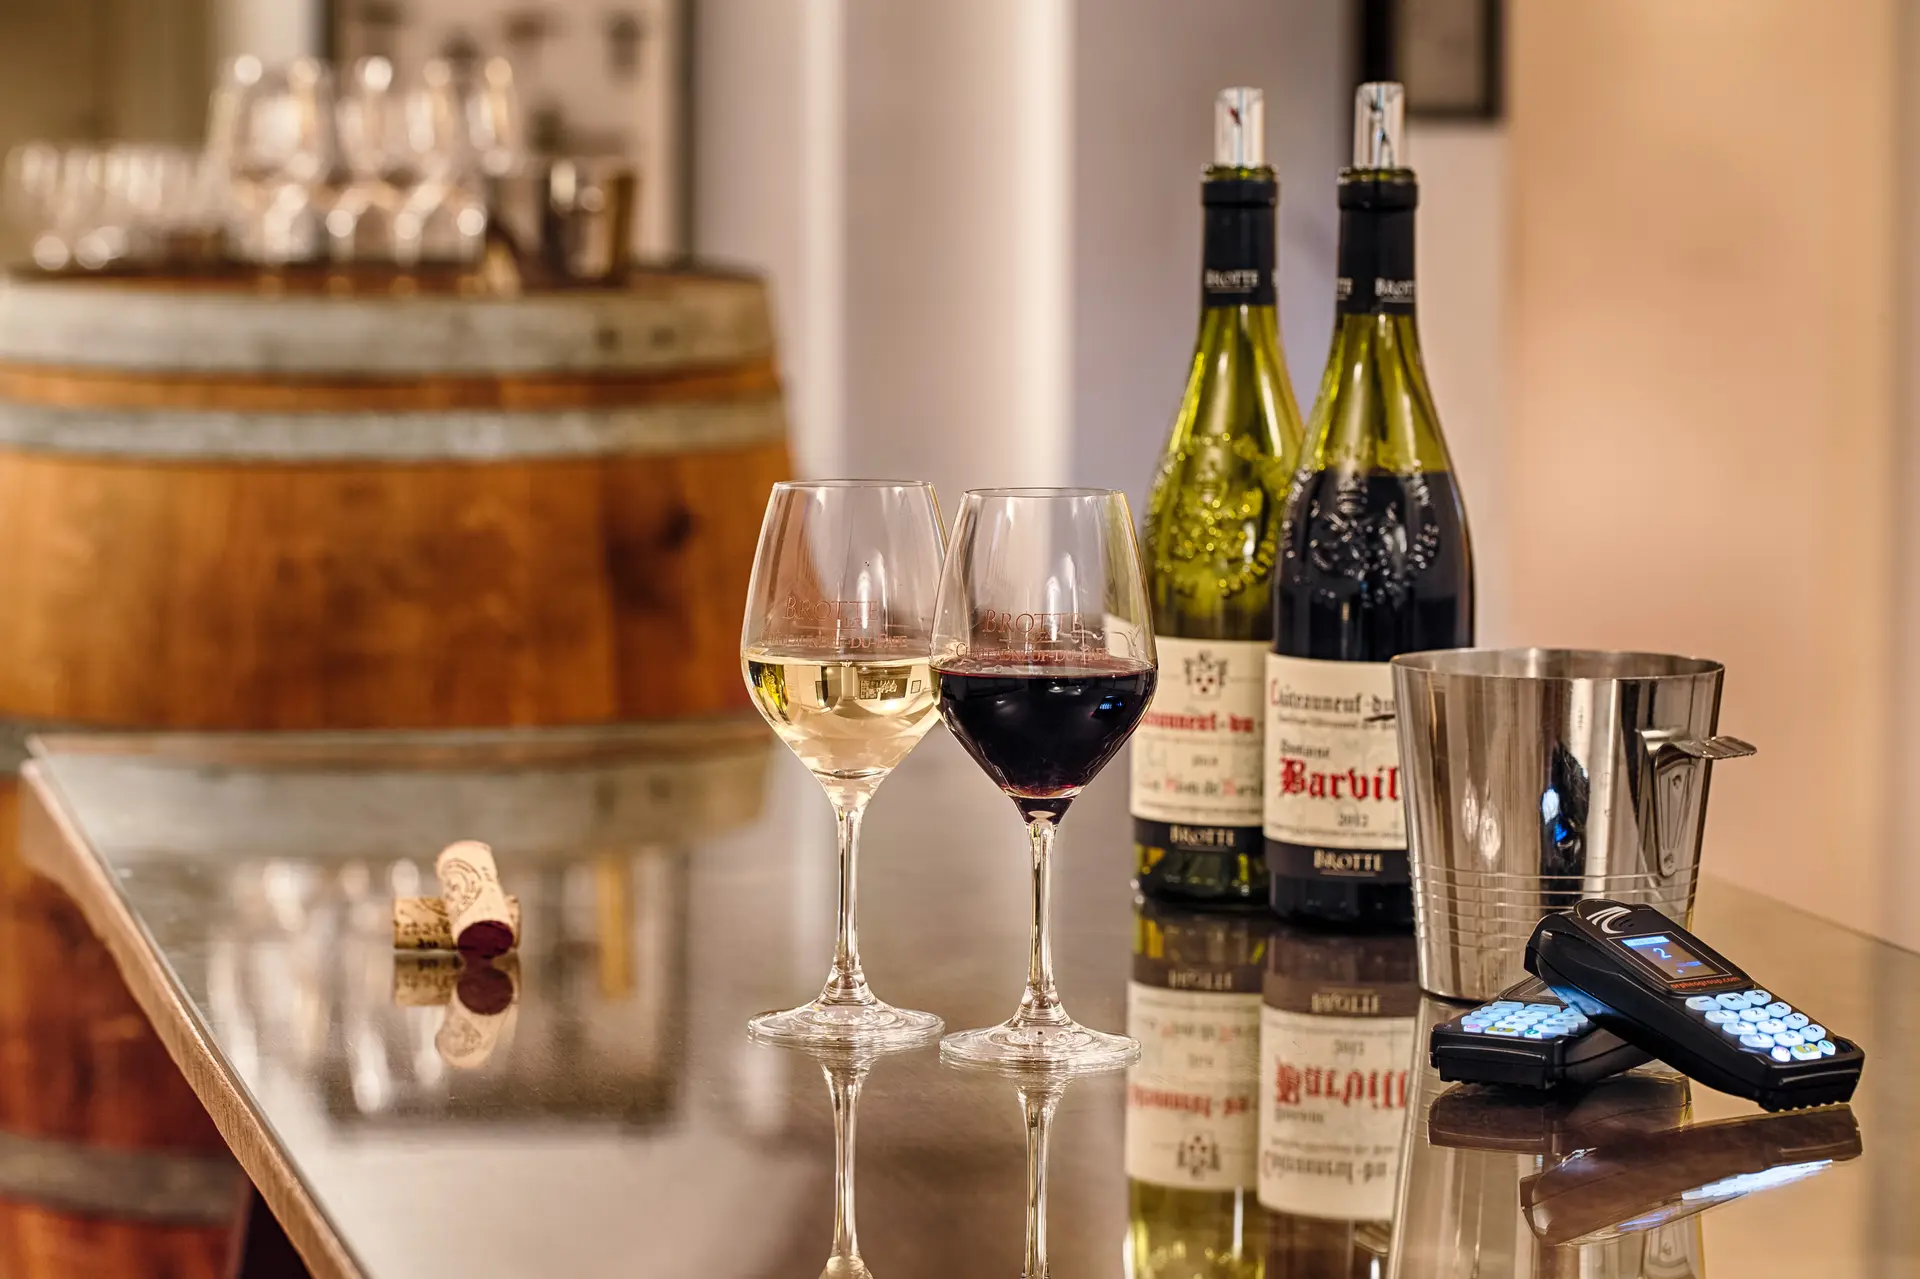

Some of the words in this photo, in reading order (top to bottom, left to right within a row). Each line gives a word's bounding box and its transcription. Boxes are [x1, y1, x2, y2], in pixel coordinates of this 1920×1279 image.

[783, 595, 879, 622] BROTTE
[982, 608, 1083, 633] BROTTE
[1279, 757, 1399, 802] Barvil
[1337, 812, 1369, 829] 2012
[1170, 824, 1235, 845] BROTTE
[1313, 849, 1383, 872] BROTTE
